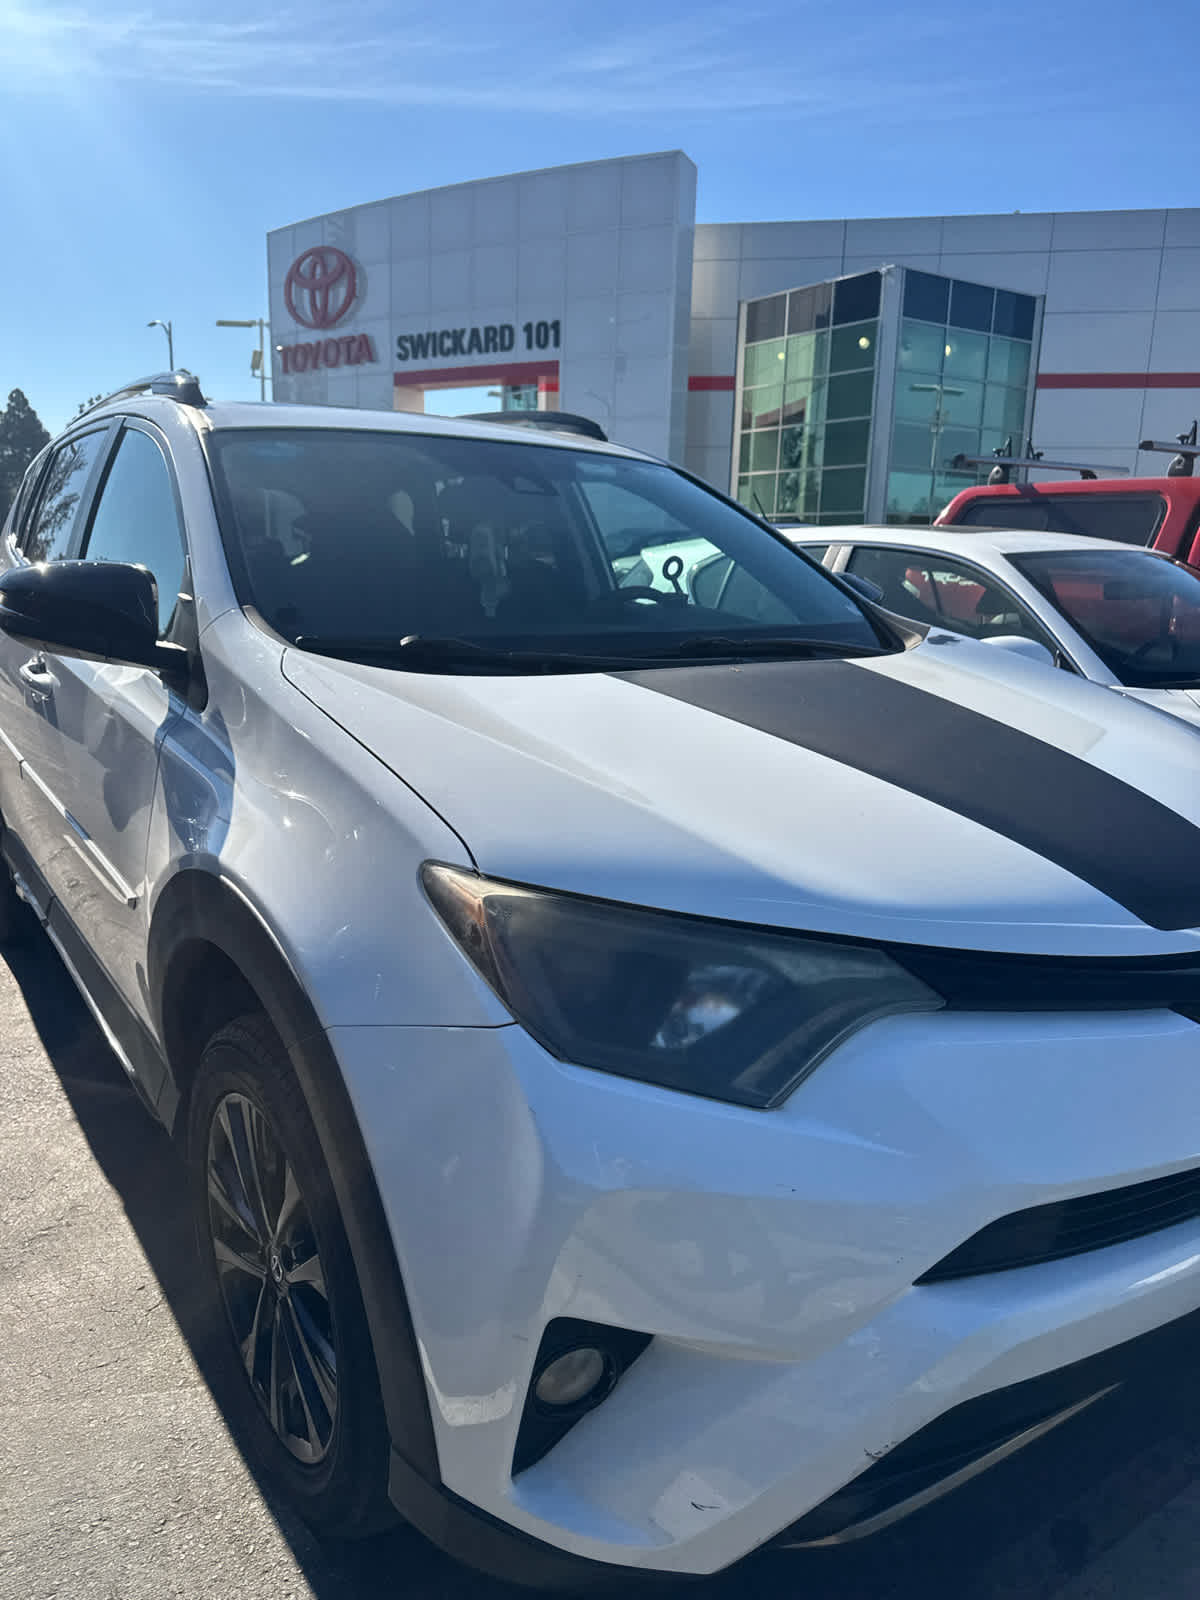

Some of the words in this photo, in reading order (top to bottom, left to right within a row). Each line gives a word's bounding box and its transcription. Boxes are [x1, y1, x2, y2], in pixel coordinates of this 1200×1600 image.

[280, 333, 376, 374] TOYOTA
[396, 324, 514, 361] SWICKARD
[523, 320, 561, 350] 101
